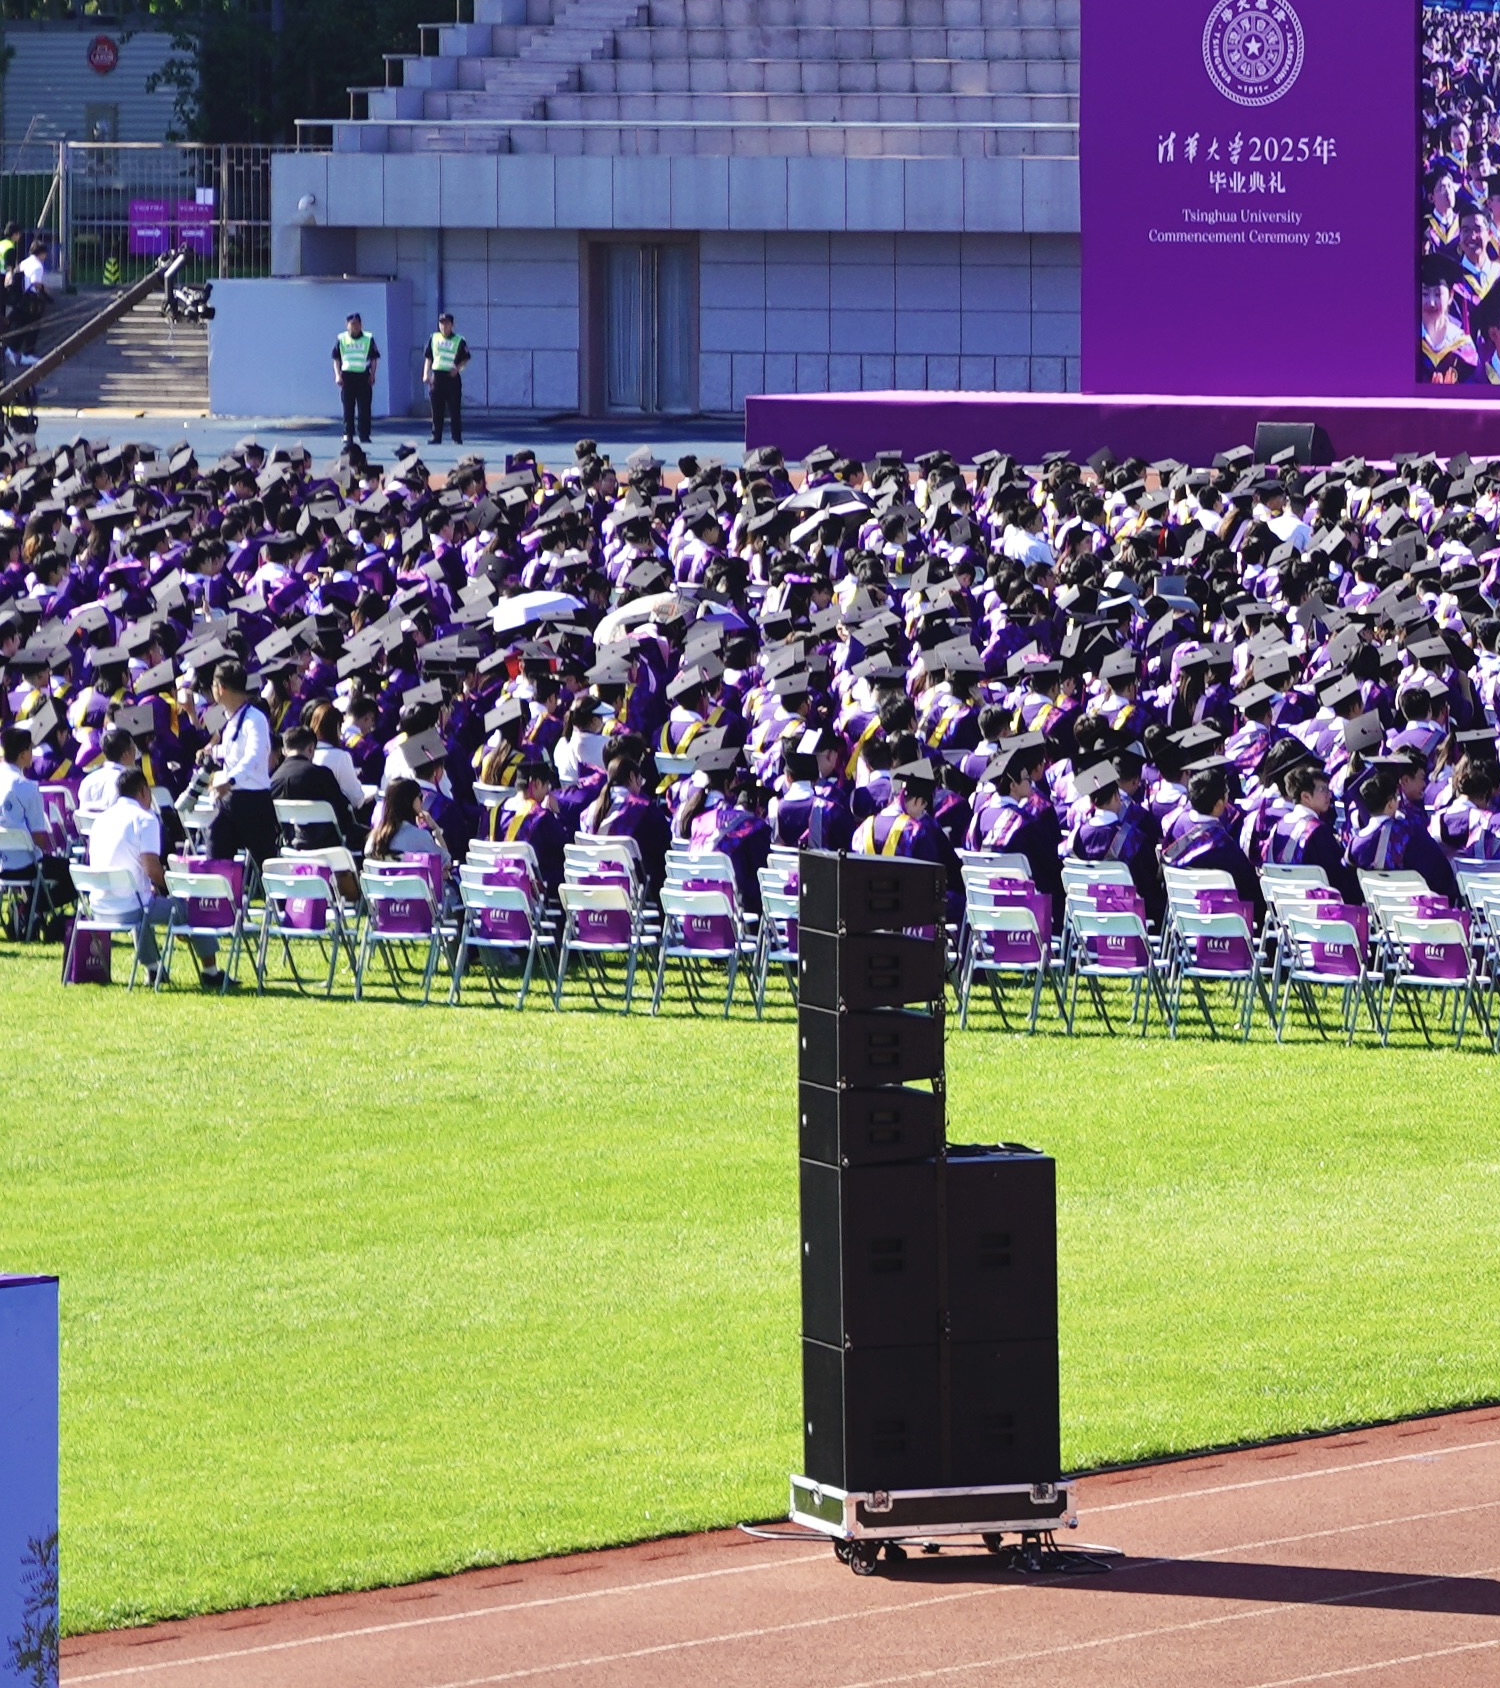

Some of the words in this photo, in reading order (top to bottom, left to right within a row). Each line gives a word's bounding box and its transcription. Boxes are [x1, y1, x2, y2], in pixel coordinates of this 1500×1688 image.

[1209, 170, 1286, 194] 毕业典礼
[1182, 209, 1237, 226] Tsinghua
[1240, 209, 1303, 226] University
[1148, 229, 1246, 244] Commencement
[1249, 229, 1311, 246] Ceremony
[1315, 231, 1341, 245] 2025
